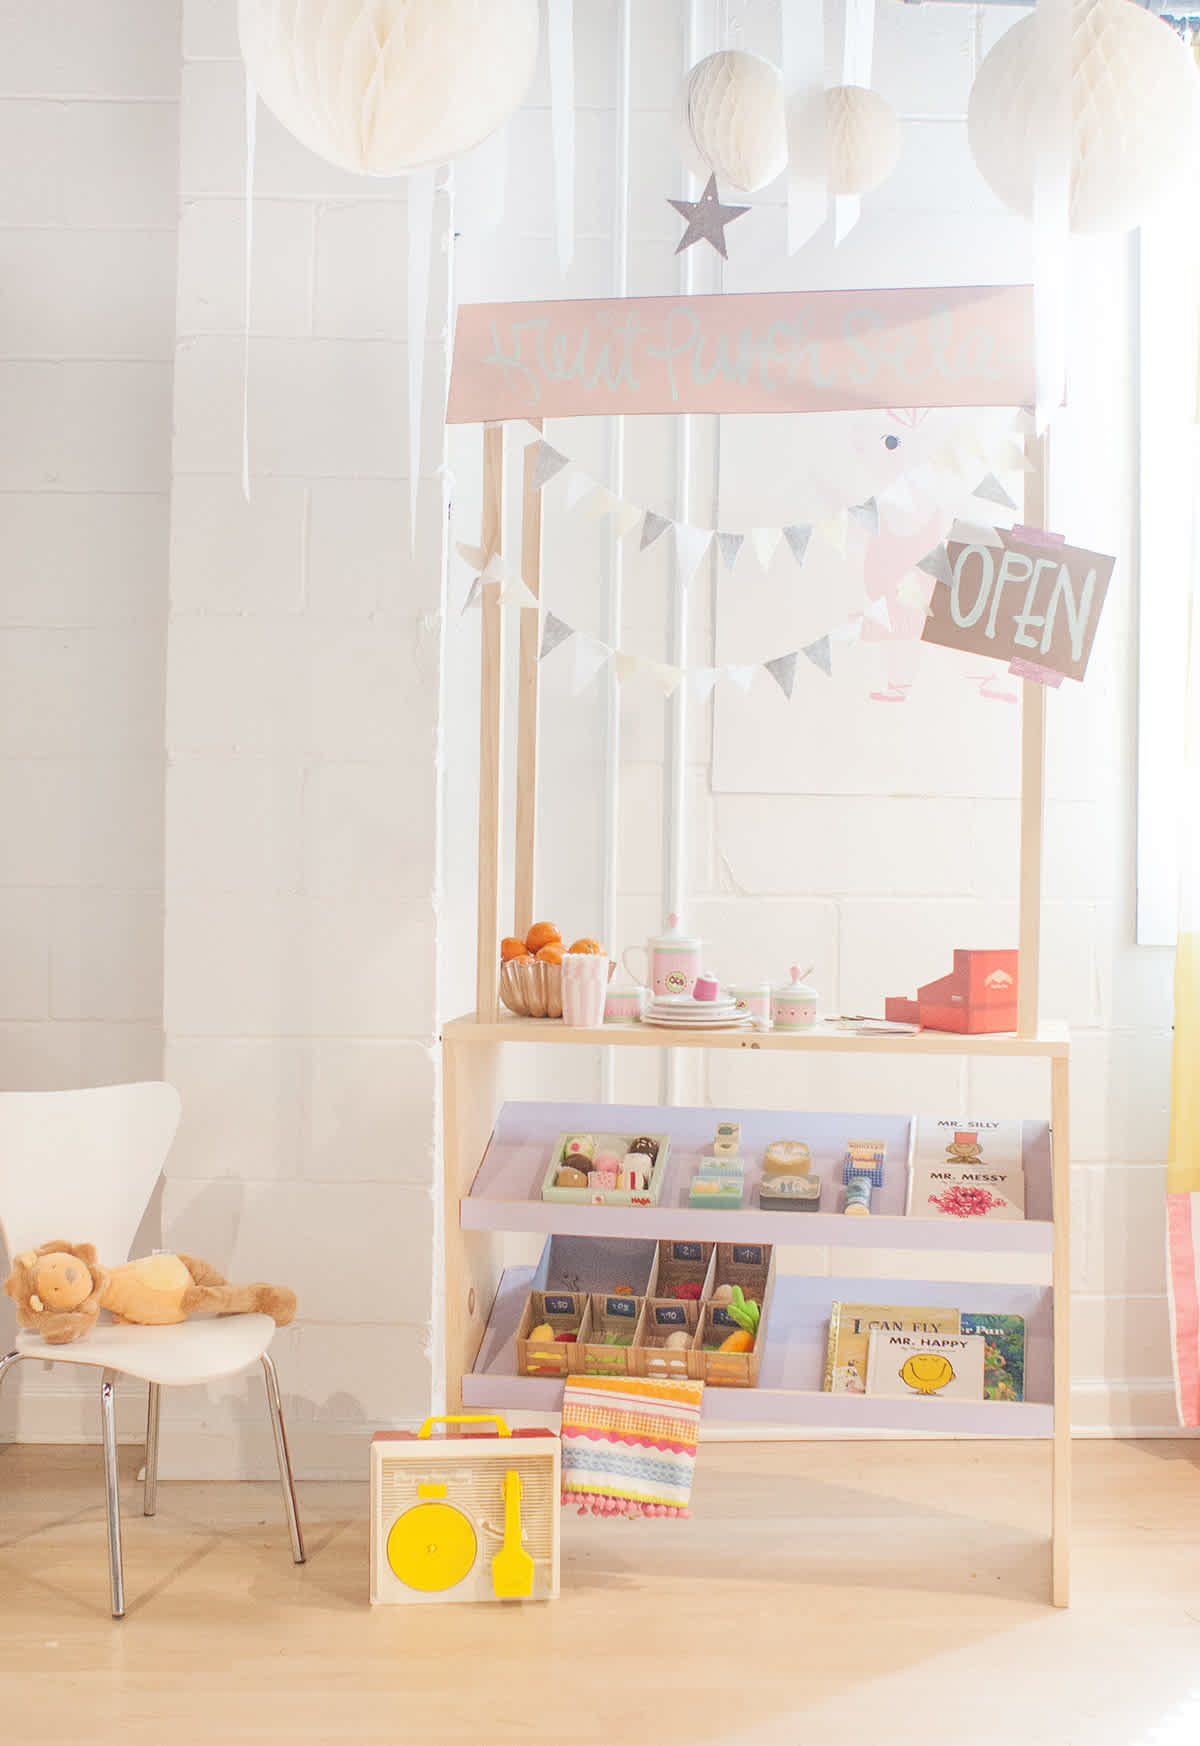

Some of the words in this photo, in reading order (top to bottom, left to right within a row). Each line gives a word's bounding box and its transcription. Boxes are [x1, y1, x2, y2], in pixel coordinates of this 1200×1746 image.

[950, 544, 1096, 662] OPEN
[937, 1120, 962, 1128] MR.
[967, 1121, 1000, 1129] SILLY
[930, 1172, 956, 1180] MR.
[961, 1173, 1007, 1182] MESSY
[853, 1319, 863, 1334] I
[868, 1320, 903, 1331] CAN
[912, 1321, 943, 1333] FLY
[889, 1336, 915, 1345] MR.
[921, 1337, 968, 1349] HAPPY
